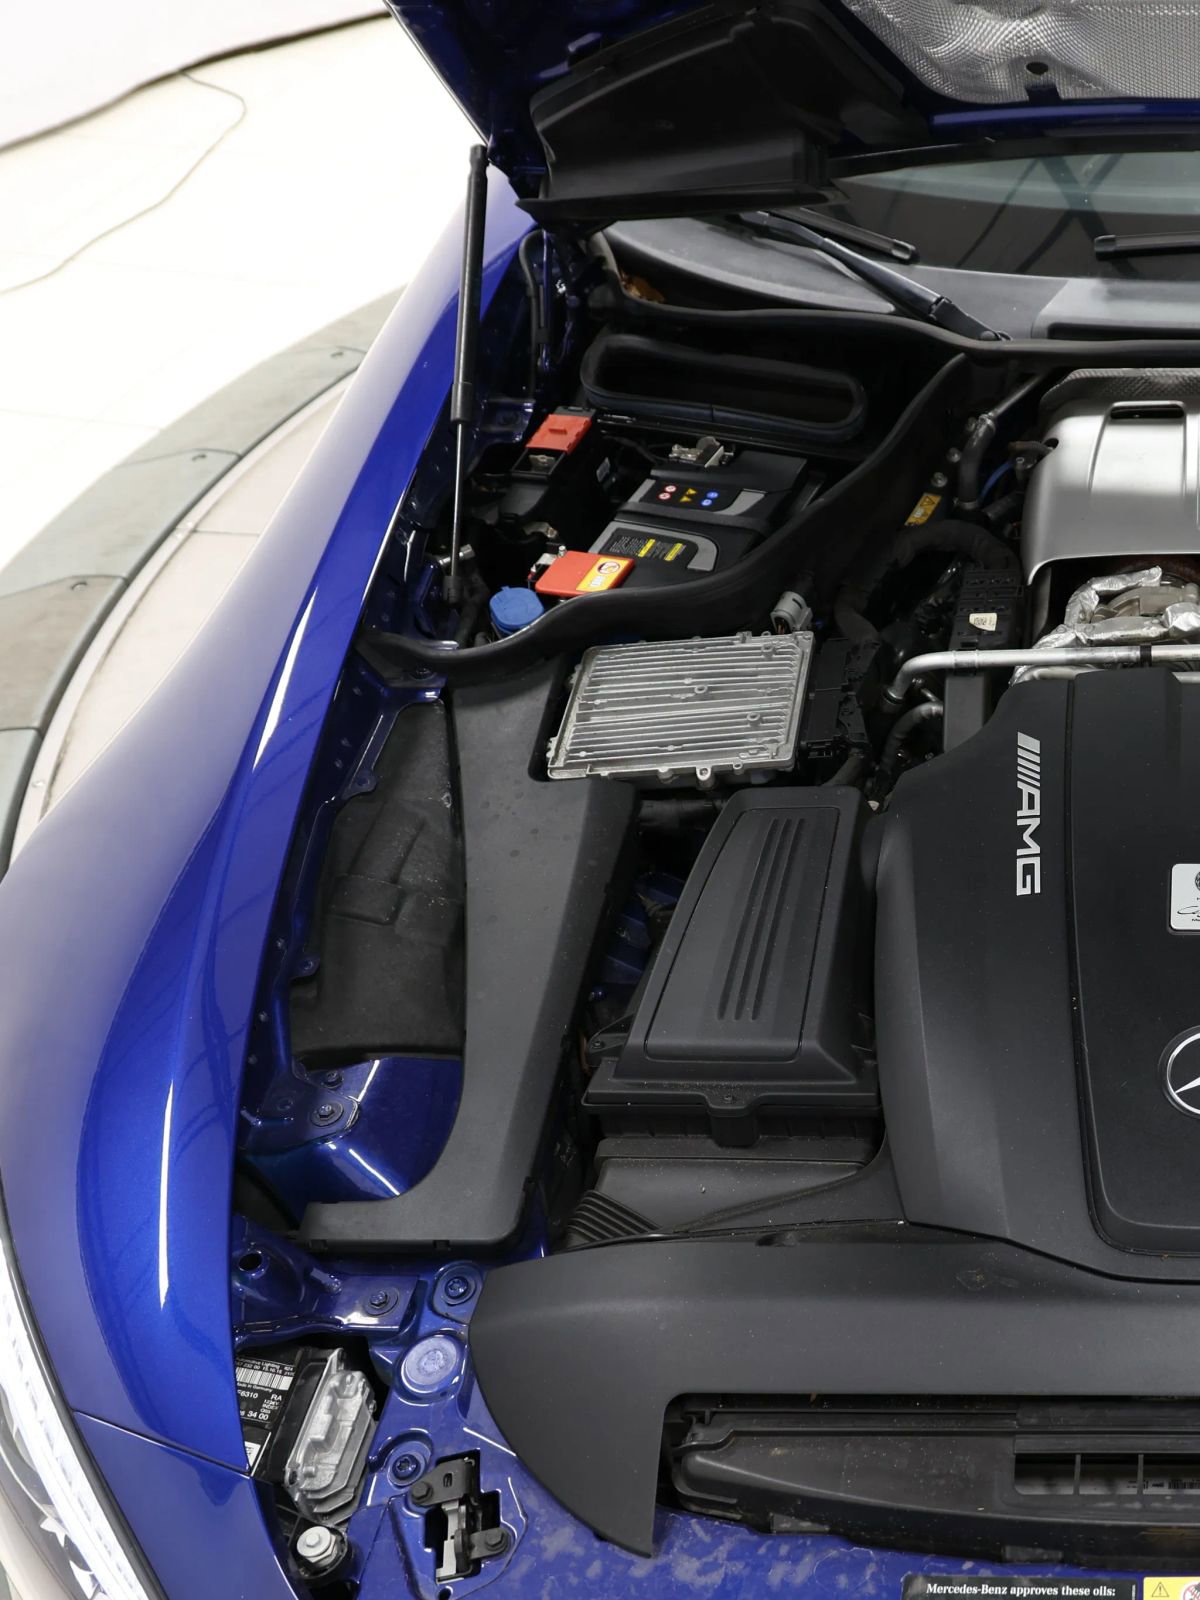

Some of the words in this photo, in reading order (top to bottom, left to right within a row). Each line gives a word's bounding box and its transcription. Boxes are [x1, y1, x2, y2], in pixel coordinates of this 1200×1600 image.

[1016, 781, 1041, 896] AMG
[247, 1410, 258, 1418] 34
[258, 1412, 269, 1421] 00
[926, 1583, 1007, 1595] Mercedes-Benz
[1010, 1585, 1059, 1597] approves
[1061, 1584, 1090, 1596] these
[1092, 1585, 1116, 1597] oils:
